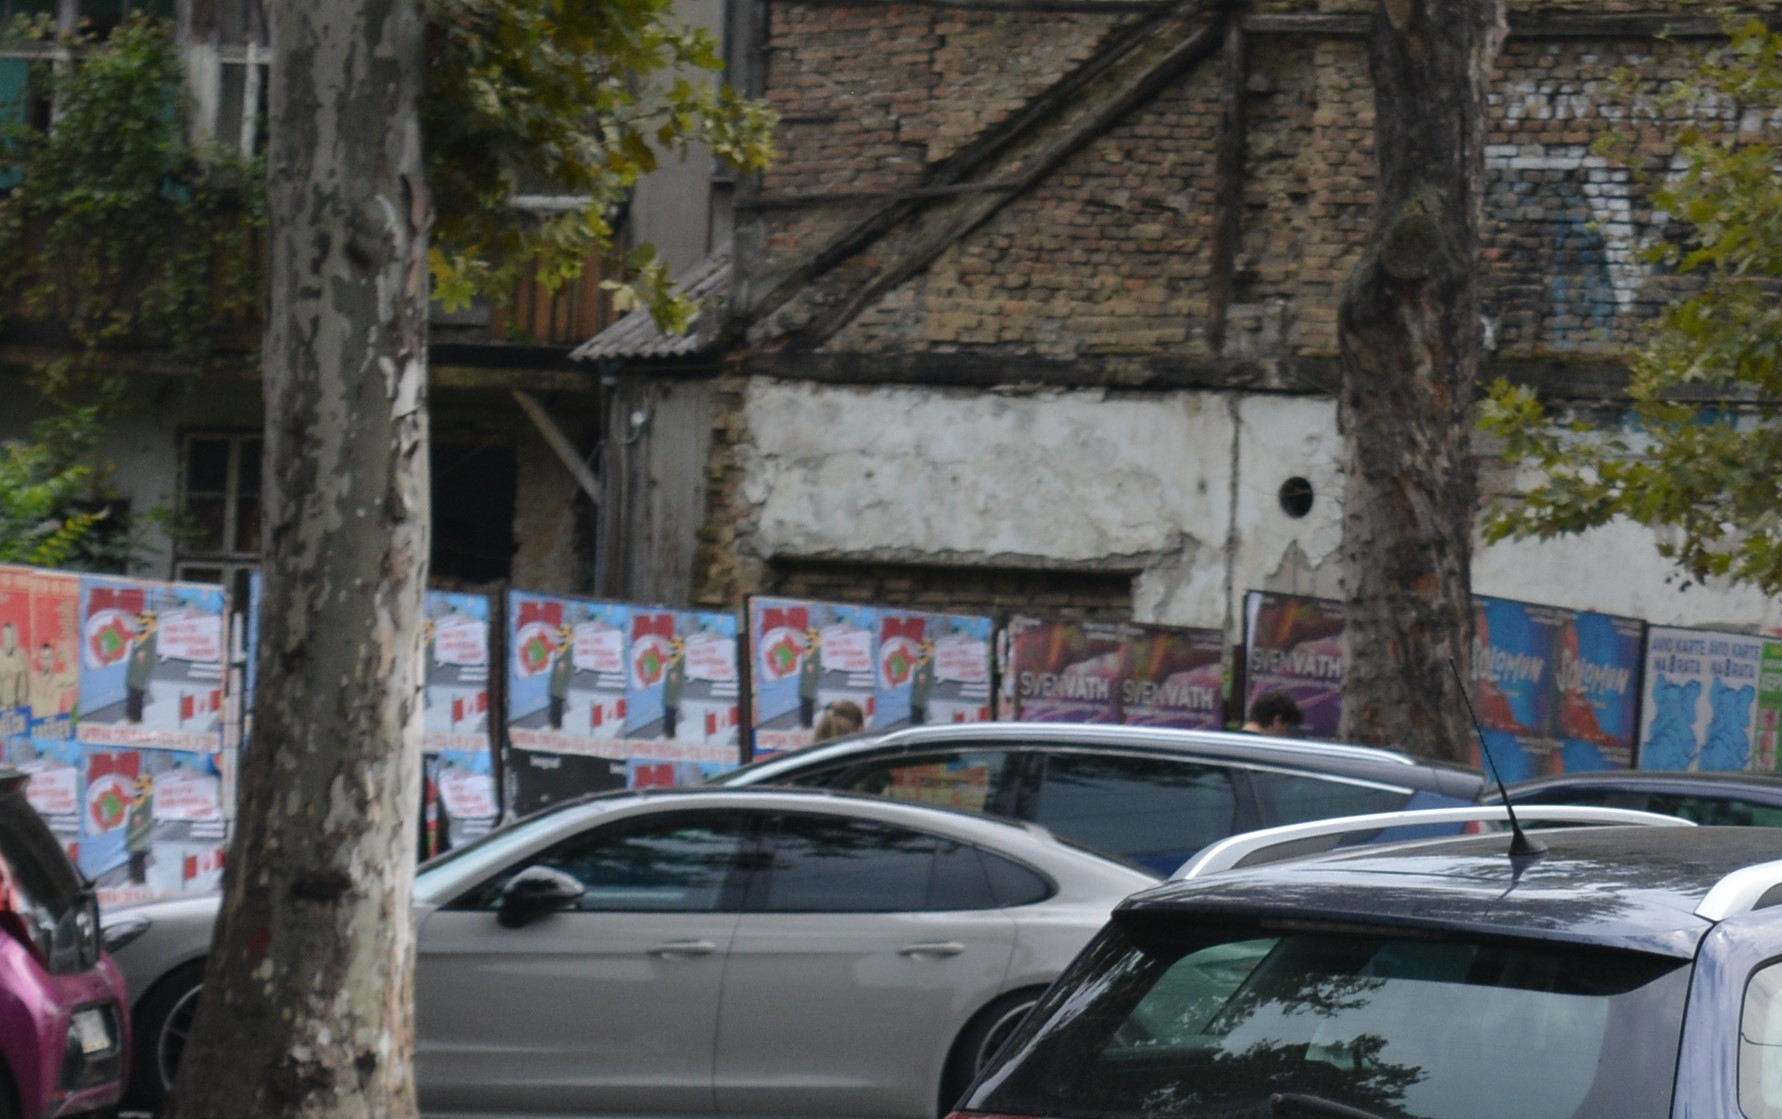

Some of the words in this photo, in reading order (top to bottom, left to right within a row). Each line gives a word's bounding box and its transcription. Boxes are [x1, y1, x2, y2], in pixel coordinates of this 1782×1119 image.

[1652, 638, 1673, 652] AVIO
[1676, 639, 1705, 655] KARTE
[1709, 640, 1730, 656] AVIO
[1732, 643, 1760, 660] KARTE
[1677, 659, 1701, 673] RATA
[1732, 663, 1755, 678] RATA
